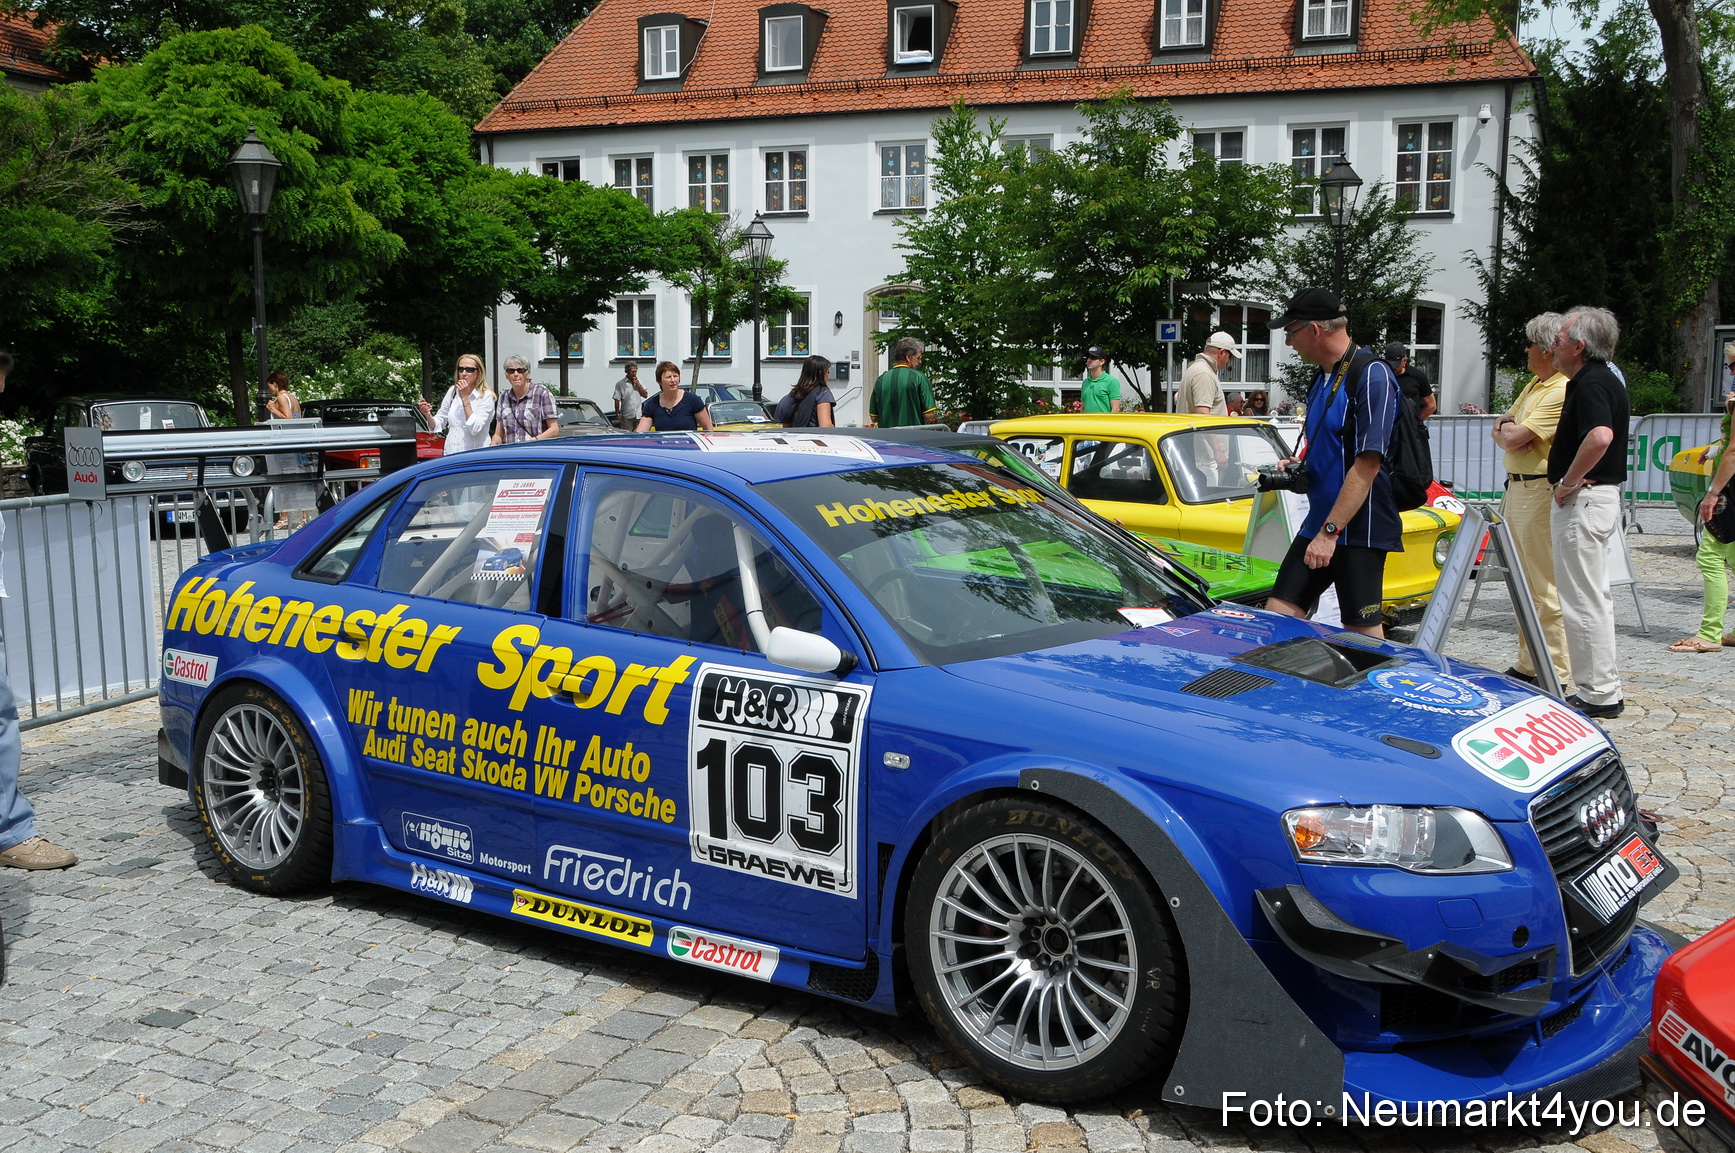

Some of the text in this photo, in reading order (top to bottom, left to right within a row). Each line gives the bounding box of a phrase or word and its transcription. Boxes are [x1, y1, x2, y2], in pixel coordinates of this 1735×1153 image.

[74, 471, 98, 483] Audi
[815, 486, 995, 528] Hohenester
[167, 577, 698, 725] Hohenester Sport
[173, 655, 209, 682] Castrol
[714, 676, 798, 733] H&R
[347, 688, 651, 783] Wir tunen auch Ihr Auto
[1494, 704, 1594, 764] Castrol
[362, 728, 677, 824] Audi Seat Skoda VW Porsche
[697, 738, 845, 857] 103
[447, 846, 472, 860] Sitze
[480, 853, 532, 875] Motorsport
[708, 844, 836, 891] GRAEWE
[410, 861, 453, 898] H&R
[543, 844, 692, 911] Friedrich
[530, 898, 651, 938] DUNLOP
[691, 935, 763, 973] Castrol
